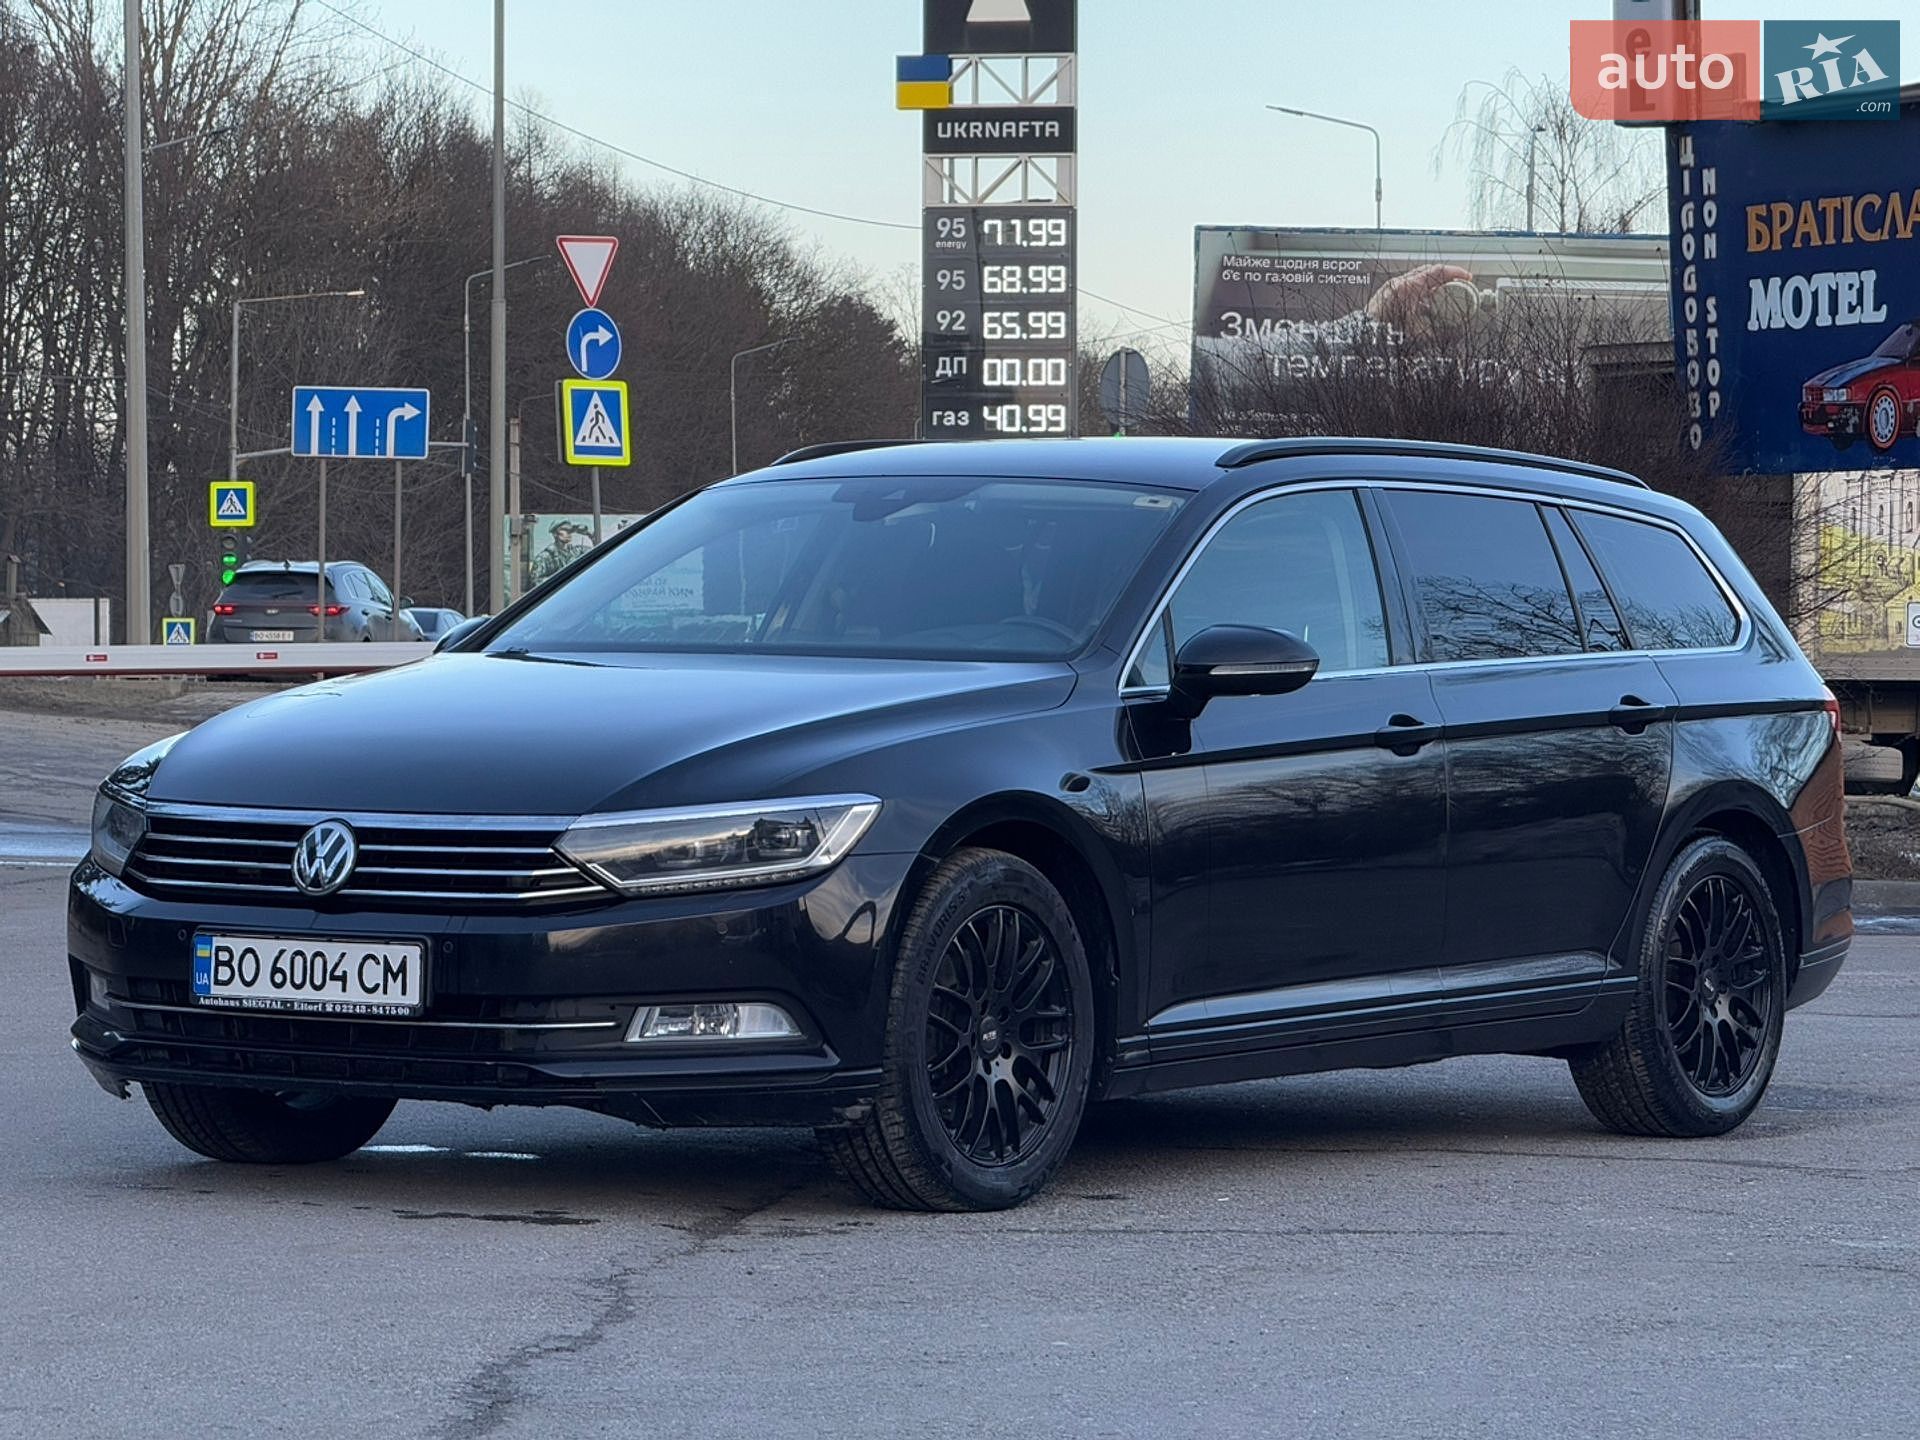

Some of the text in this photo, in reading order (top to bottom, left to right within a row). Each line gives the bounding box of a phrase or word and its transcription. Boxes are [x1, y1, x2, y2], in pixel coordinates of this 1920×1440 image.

[937, 121, 1060, 139] UKRNAFTA
[936, 217, 966, 239] 95
[935, 241, 967, 249] energy
[1222, 255, 1271, 268] Майже
[1274, 259, 1319, 271] щодня
[936, 265, 1066, 294] 95 68.99
[1244, 271, 1262, 281] по
[1265, 271, 1314, 284] газовій
[1317, 272, 1371, 285] системі
[1747, 269, 1887, 331] MOTEL
[936, 310, 1066, 340] 92 65.99
[1706, 296, 1720, 419] STOP
[935, 357, 1066, 387] ДП 00.00
[932, 404, 1066, 433] газ 40.99
[196, 972, 209, 985] UA
[213, 945, 408, 996] BO 6004 CM
[198, 996, 240, 1007] Autohaus
[242, 998, 284, 1009] SIEGTAL
